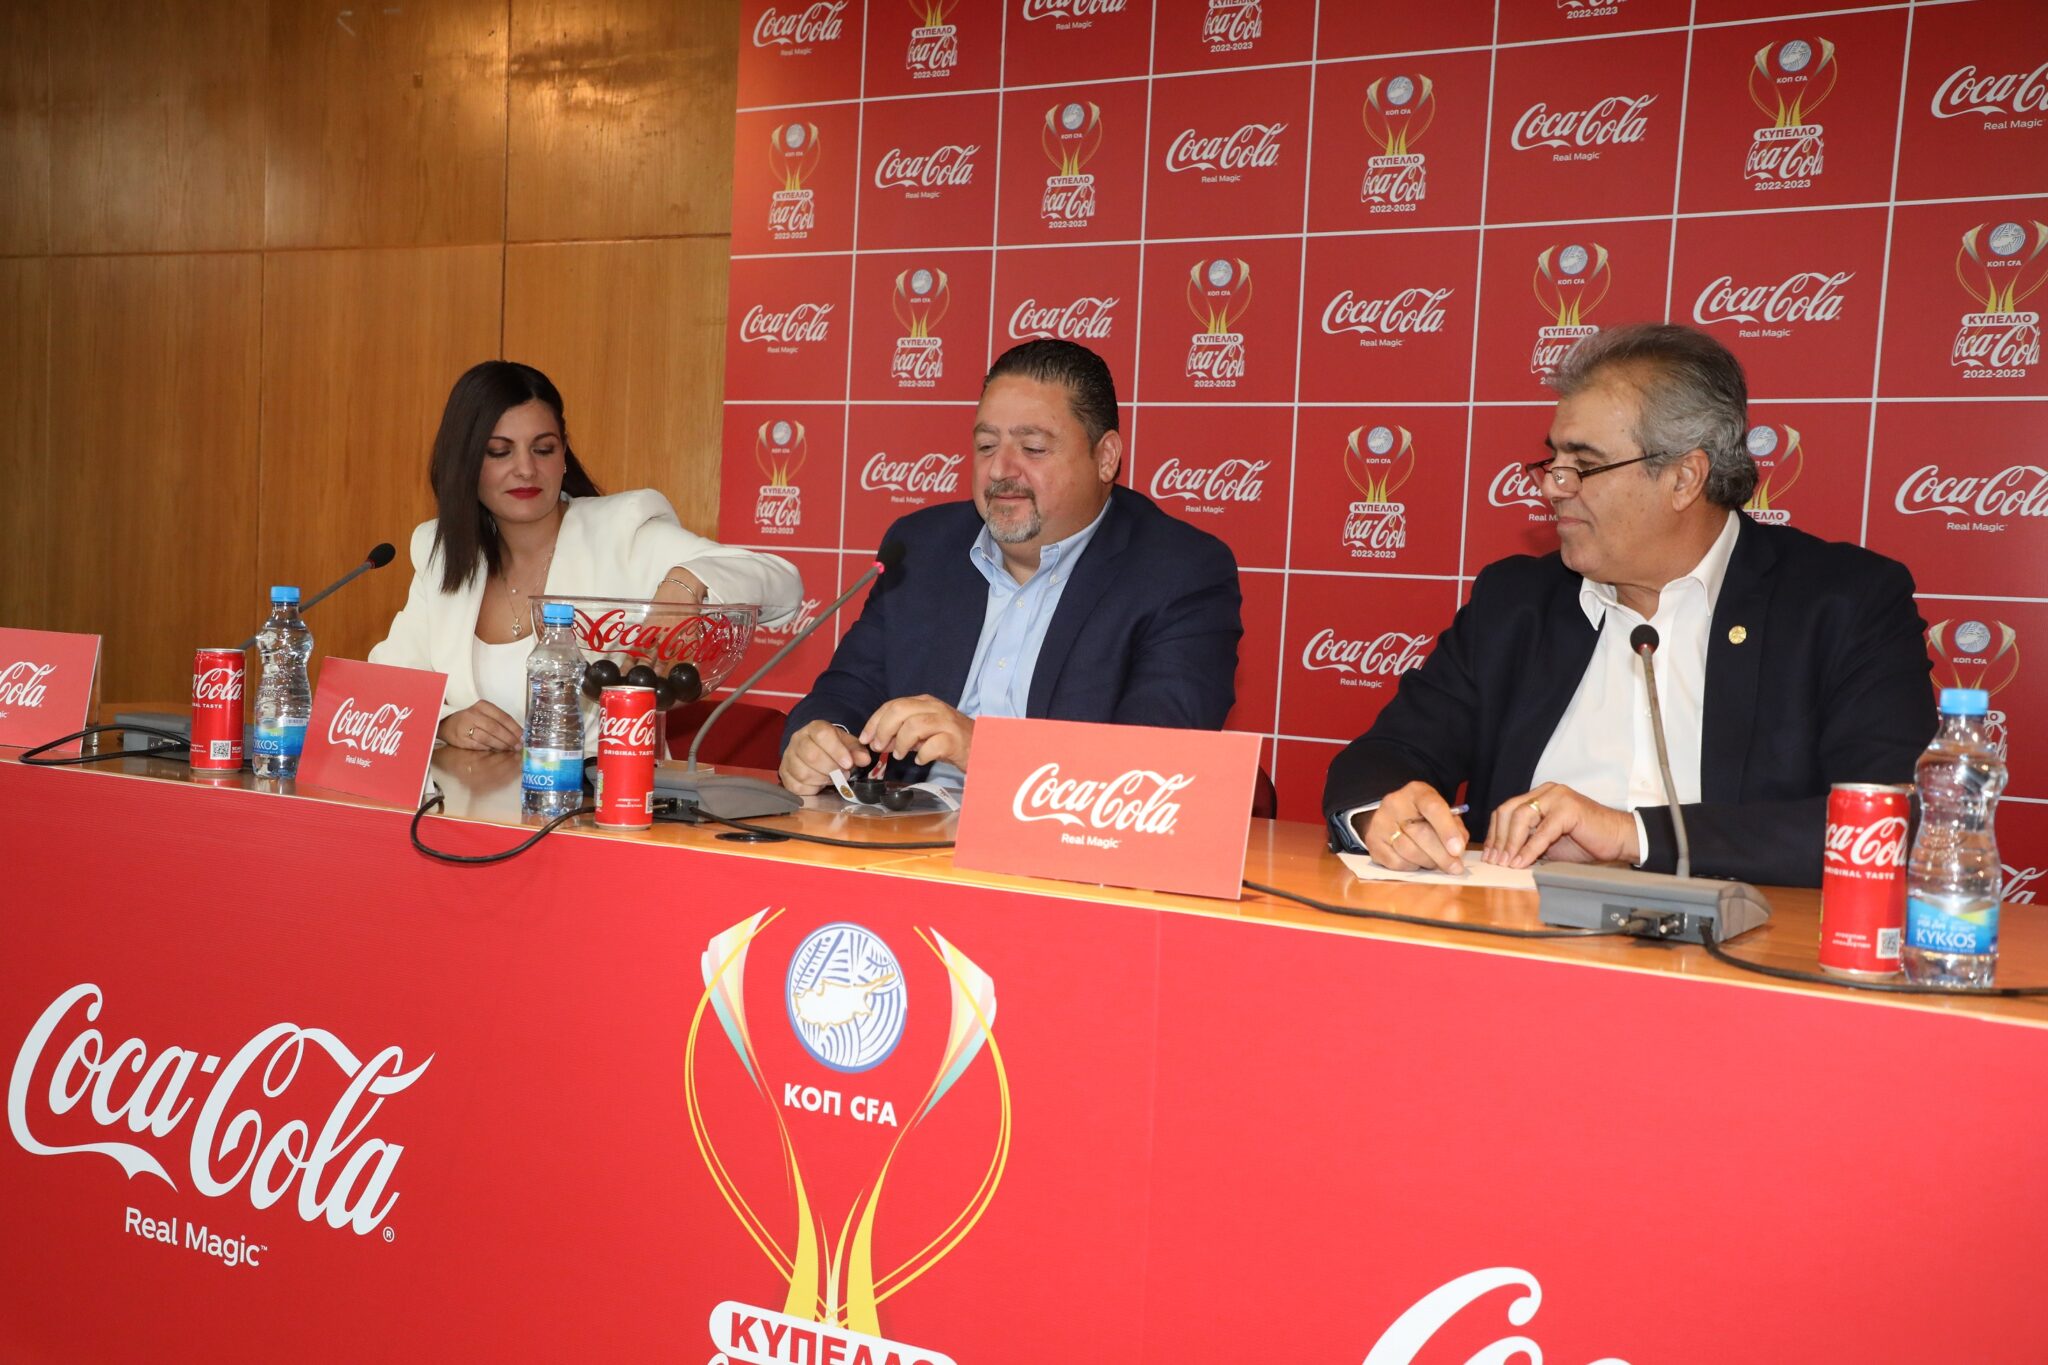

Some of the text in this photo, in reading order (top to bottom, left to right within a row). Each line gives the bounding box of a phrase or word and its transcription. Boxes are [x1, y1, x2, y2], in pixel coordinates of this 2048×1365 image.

[1567, 7, 1617, 19] 2022-2023
[753, 0, 848, 48] Coca-Cola
[1211, 41, 1253, 52] 2022-2023
[913, 68, 950, 79] 2022-2023
[1931, 62, 2048, 118] Coca-C
[1511, 95, 1657, 150] Coca-Cola
[1984, 119, 2043, 130] Real Magic
[1760, 127, 1816, 138] ΚΥΠΕΛΛΟ
[1166, 123, 1288, 172] Coca-Cola
[1373, 156, 1420, 166] ΚΥΠΕΛΛΟ
[1553, 152, 1599, 161] Real Magic
[875, 145, 980, 188] Coca-Cola
[1051, 176, 1090, 185] ΚΥΠΕΛΛΟ
[1755, 180, 1811, 190] 2022-2023
[1370, 204, 1416, 213] 2022-2023
[1049, 220, 1087, 228] 2022-2023
[1693, 272, 1855, 324] Coca-Cola
[1322, 288, 1454, 334] Coca-Cola
[740, 304, 834, 342] Coca-Cola
[1008, 297, 1119, 339] Coca-Cola
[1968, 315, 2032, 324] ΚΥΠΕΛΛΟ
[1544, 327, 1593, 336] ΚΥΠΕΛΛΟ
[1762, 329, 1790, 338] Magic
[1197, 335, 1239, 343] ΚΥΠΕΛΛΟ
[1379, 339, 1402, 347] Magic
[1963, 369, 2026, 378] 2022-2023
[861, 452, 964, 492] Coca-Cola
[1150, 458, 1270, 501] Coca-Cola
[1203, 506, 1224, 514] Magic
[1355, 504, 1400, 512] ΚΥΠΕΛΛΟ
[1947, 522, 2004, 532] Real Magic
[1352, 550, 1396, 558] 2022-2023
[1302, 628, 1433, 676] Coca-Cola
[1340, 678, 1382, 688] Real Magic
[328, 698, 413, 755] Coca-Cola
[346, 755, 357, 764] Real
[1012, 763, 1196, 835] Coca-Cola
[1061, 833, 1118, 849] Real Magic
[1865, 871, 1895, 880] TASTE
[7, 983, 436, 1237] Coca-Cola
[850, 1096, 898, 1127] CFA
[125, 1206, 178, 1247] Real
[731, 1311, 934, 1365] ΚΥΠΕΛ
